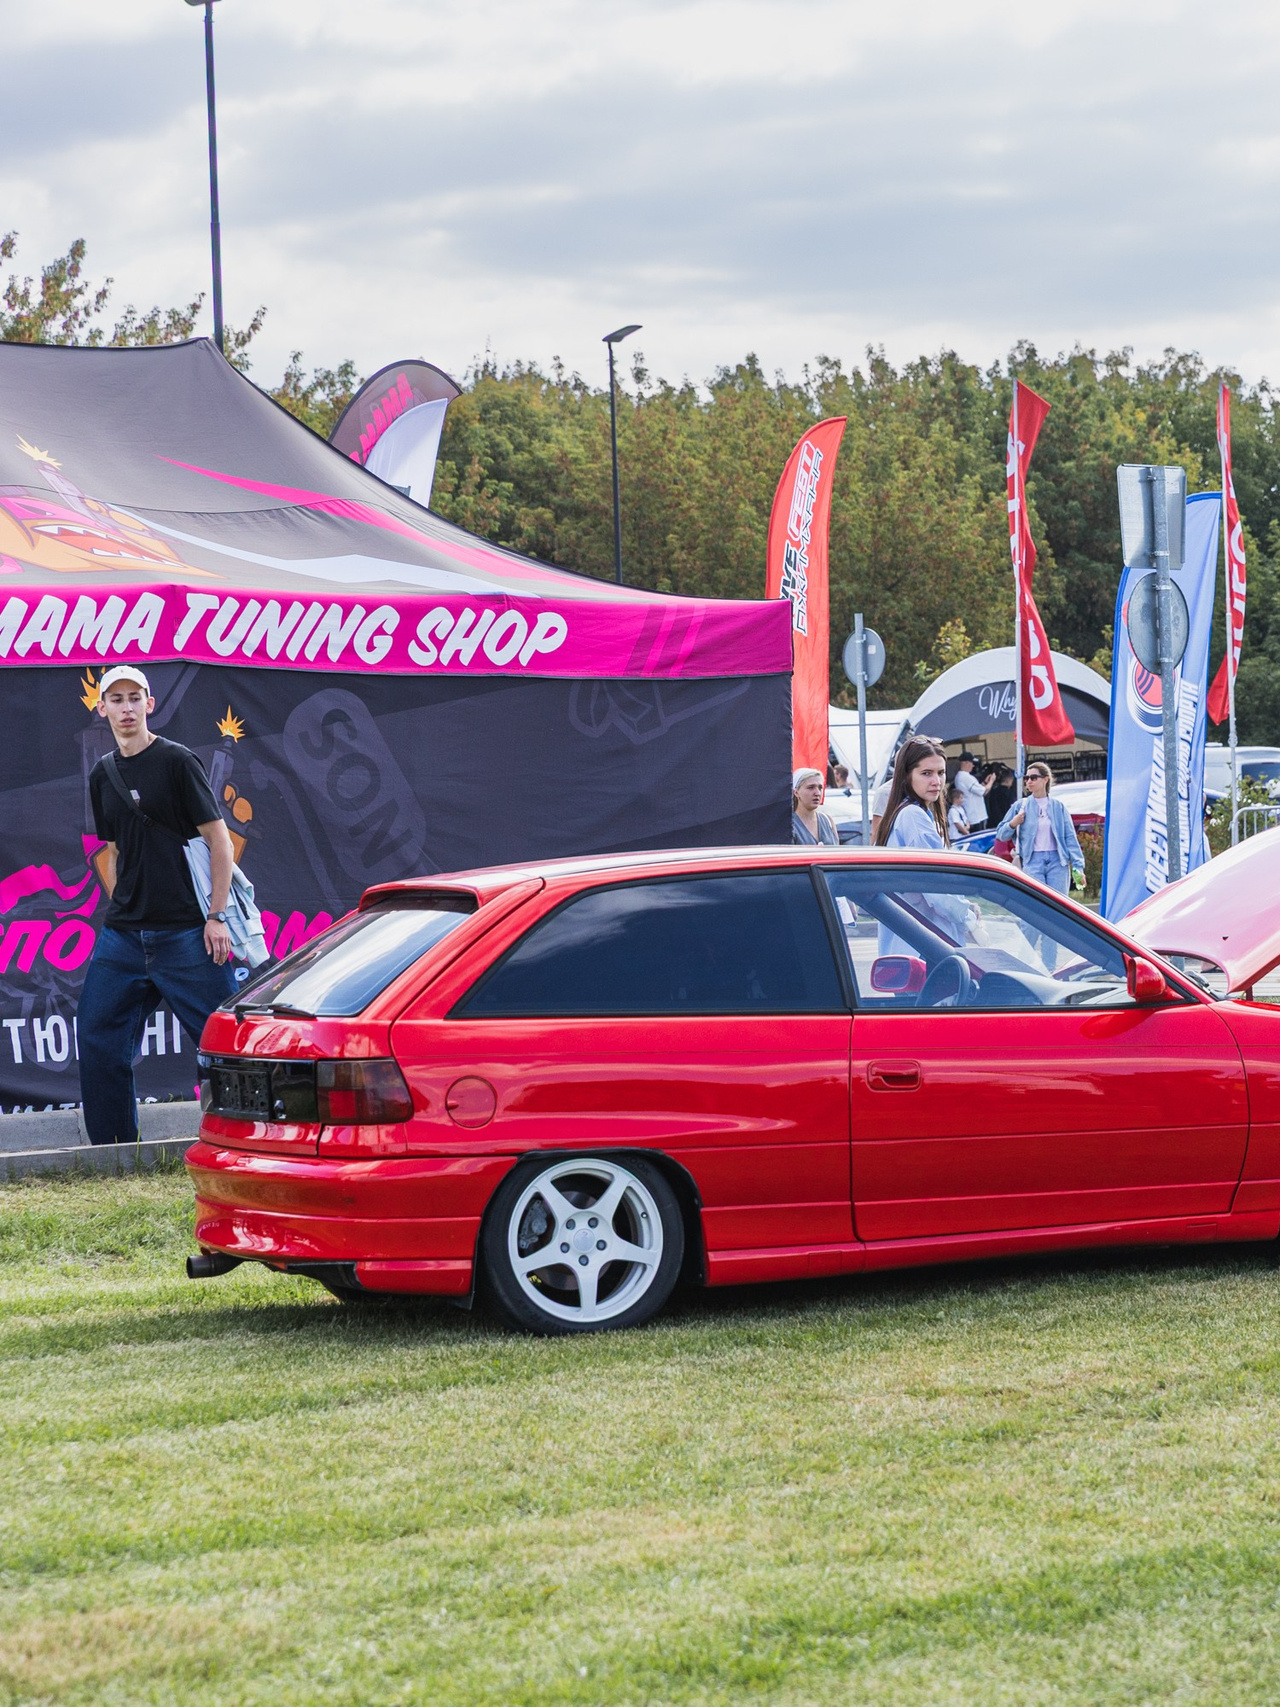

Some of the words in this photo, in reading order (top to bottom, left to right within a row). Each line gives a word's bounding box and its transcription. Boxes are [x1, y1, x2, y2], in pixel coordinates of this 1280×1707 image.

[779, 541, 799, 603] IVE
[173, 592, 401, 666] TUNING
[407, 606, 569, 668] SHOP
